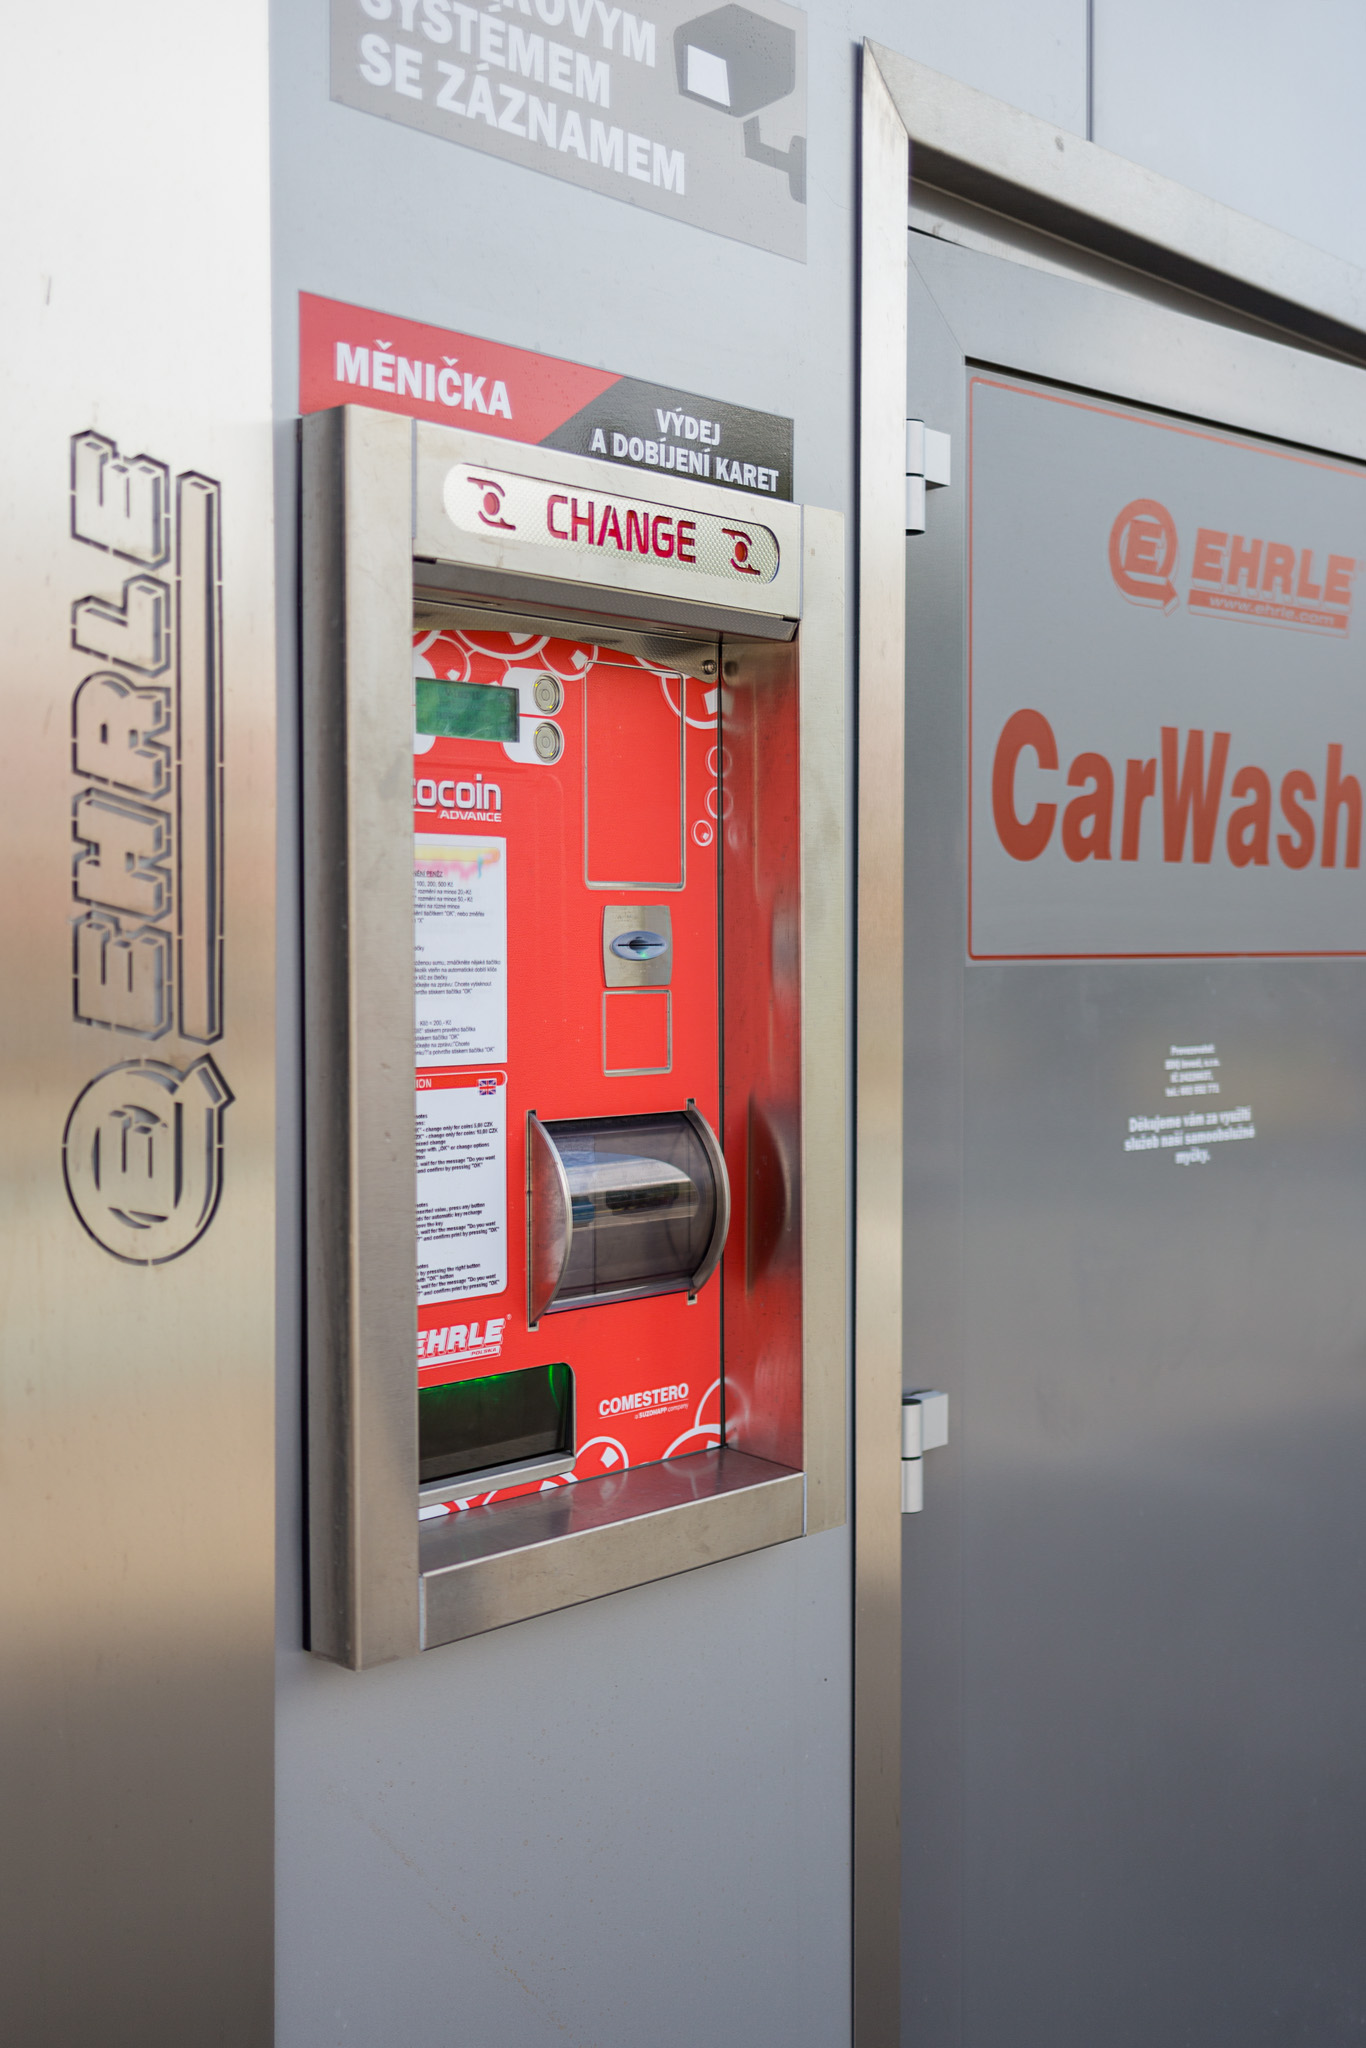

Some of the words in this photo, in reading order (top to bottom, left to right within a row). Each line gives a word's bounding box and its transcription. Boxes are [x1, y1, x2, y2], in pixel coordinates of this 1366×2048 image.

[360, 33, 423, 100] SE
[436, 62, 686, 196] ZÁZNAMEM
[334, 339, 512, 420] MĚNIČKA
[656, 406, 722, 446] VÝDEJ
[590, 428, 607, 454] A
[612, 436, 711, 477] DOBÍJENÍ
[715, 458, 779, 493] KARET
[546, 493, 697, 565] CHANGE
[1191, 527, 1356, 606] EHRLE
[1209, 597, 1335, 626] www.ehrle.com
[70, 429, 173, 1042] EHRLE
[414, 773, 502, 811] ocoin
[439, 810, 502, 822] ADVANCE
[991, 708, 1363, 871] CarWash
[1128, 1114, 1181, 1133] Děkujeme
[1183, 1110, 1204, 1127] vám
[1206, 1112, 1218, 1125] za
[599, 1382, 689, 1416] COMESTERO
